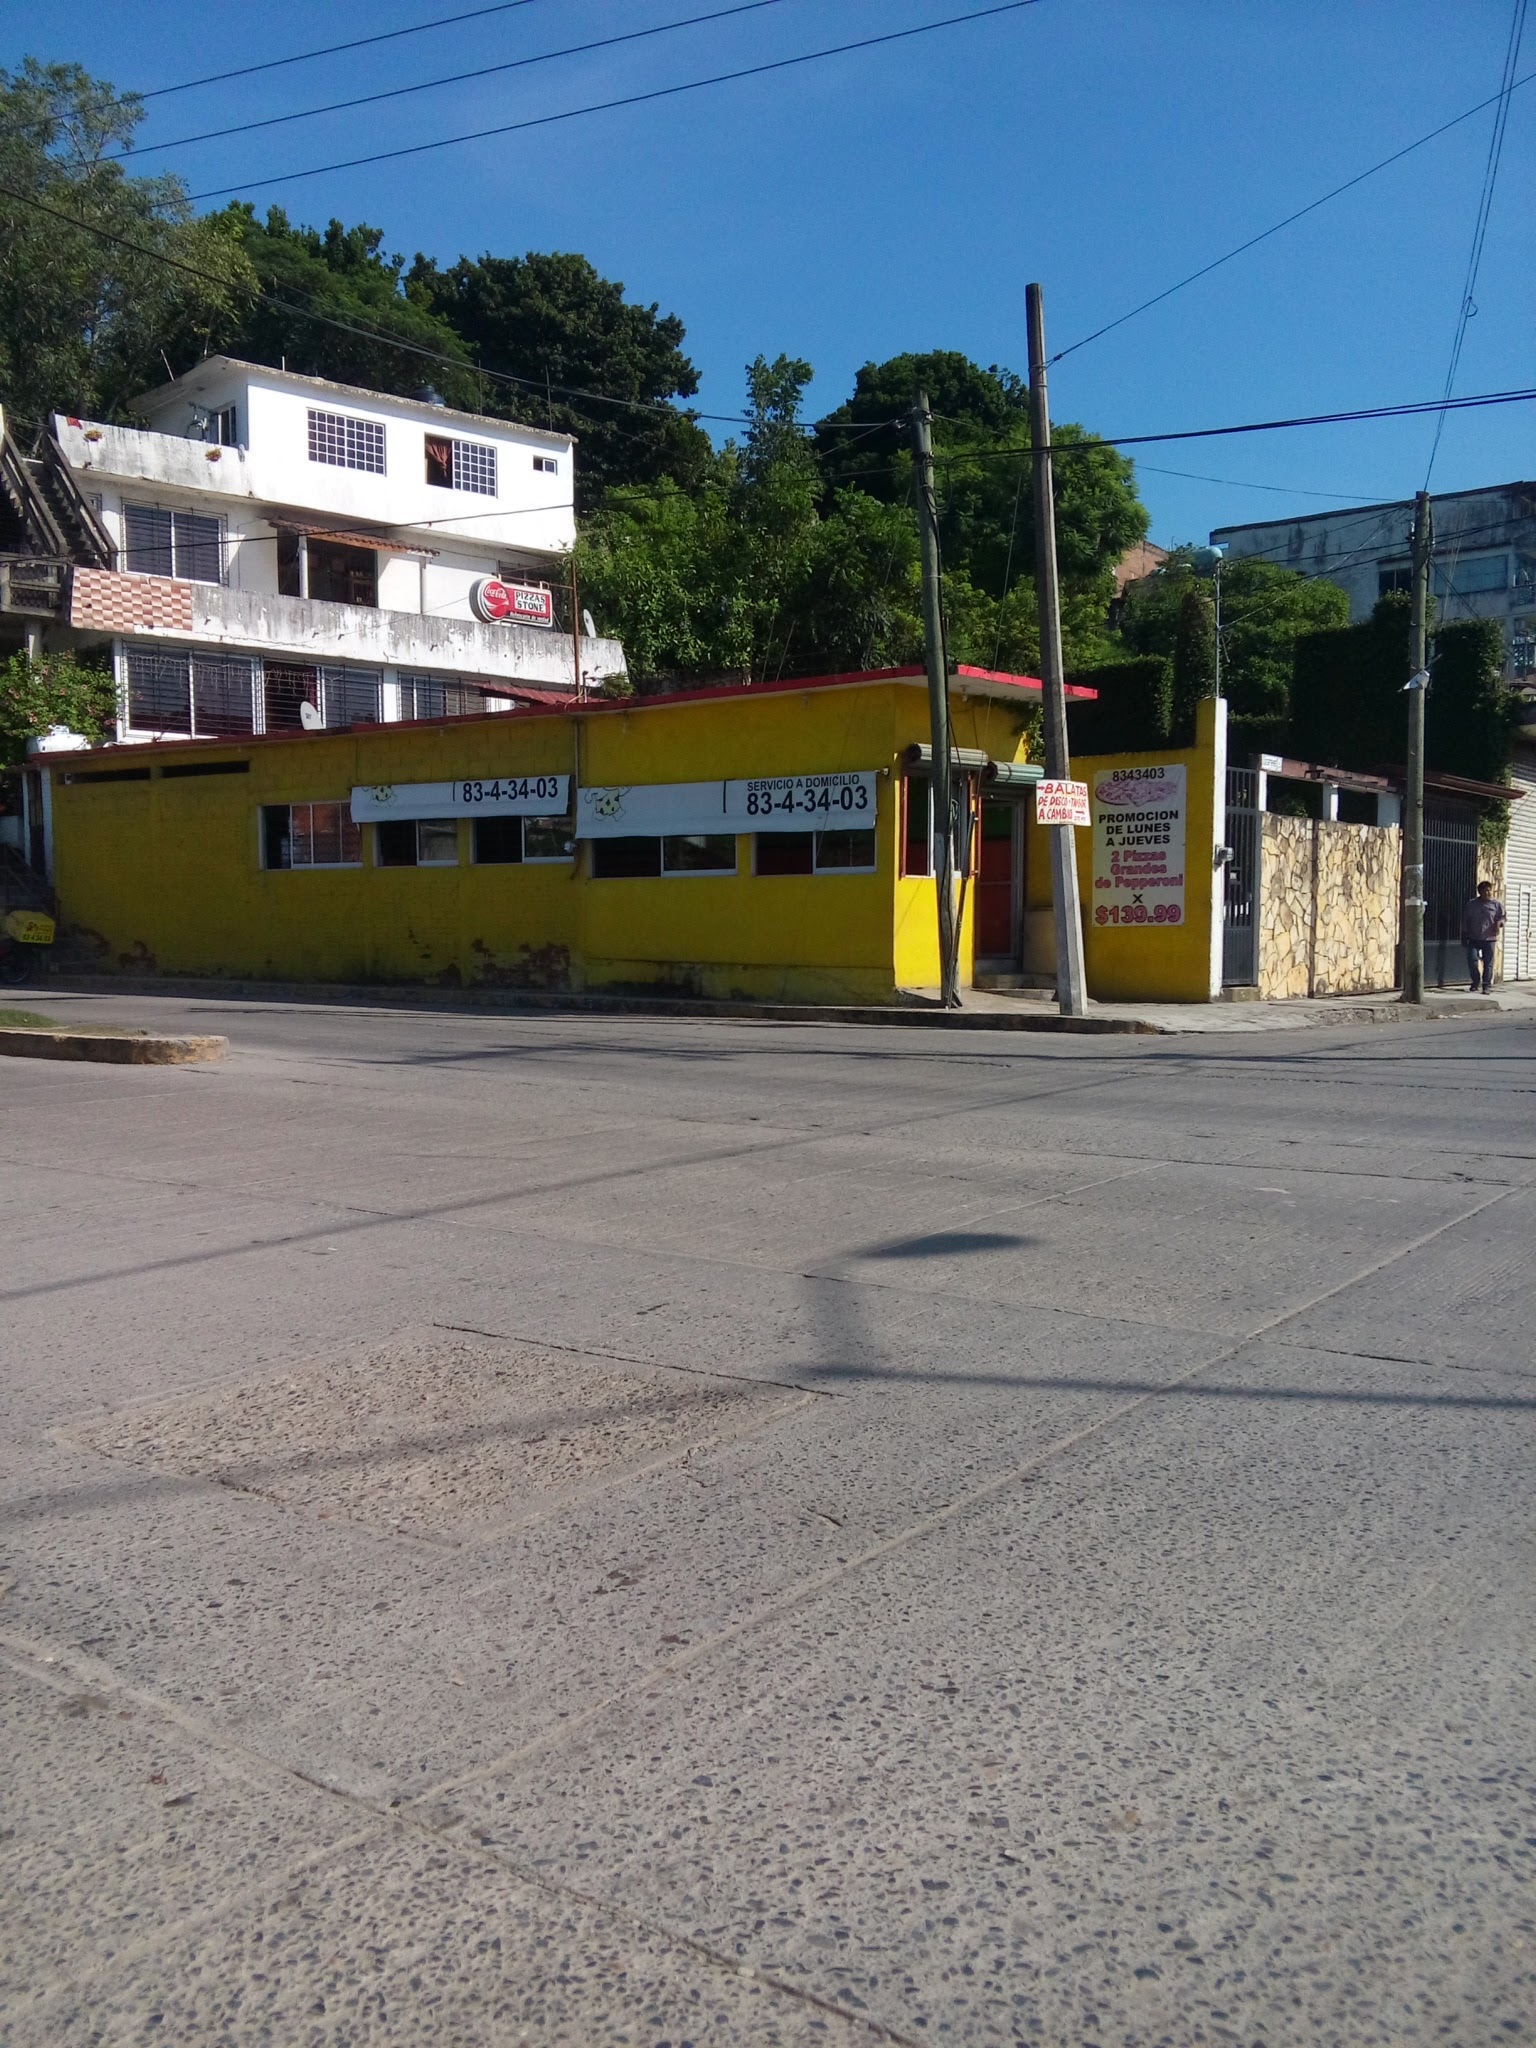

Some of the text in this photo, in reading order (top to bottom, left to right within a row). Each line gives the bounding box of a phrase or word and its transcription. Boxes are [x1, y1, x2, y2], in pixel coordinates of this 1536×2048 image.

[516, 591, 545, 603] PIZZAS
[517, 601, 544, 612] STONE
[1112, 767, 1165, 782] 8343403
[747, 774, 860, 791] SERVICIO A DOMICILIO
[463, 777, 558, 802] 83-4-34-03
[1044, 782, 1087, 797] BALATAS
[747, 785, 868, 815] 83-4-34-03
[1037, 796, 1048, 806] DE
[1038, 808, 1045, 820] A
[1047, 808, 1073, 820] CAMBIO
[1098, 810, 1179, 824] PROMOCION
[1106, 822, 1171, 835] DE LUNES
[1106, 834, 1171, 847] A JUEVES
[1111, 850, 1167, 862] 2 Pizzas
[1110, 862, 1167, 875] Grandes
[1095, 874, 1184, 890] de Pepperoni
[1095, 904, 1182, 926] $139.99
